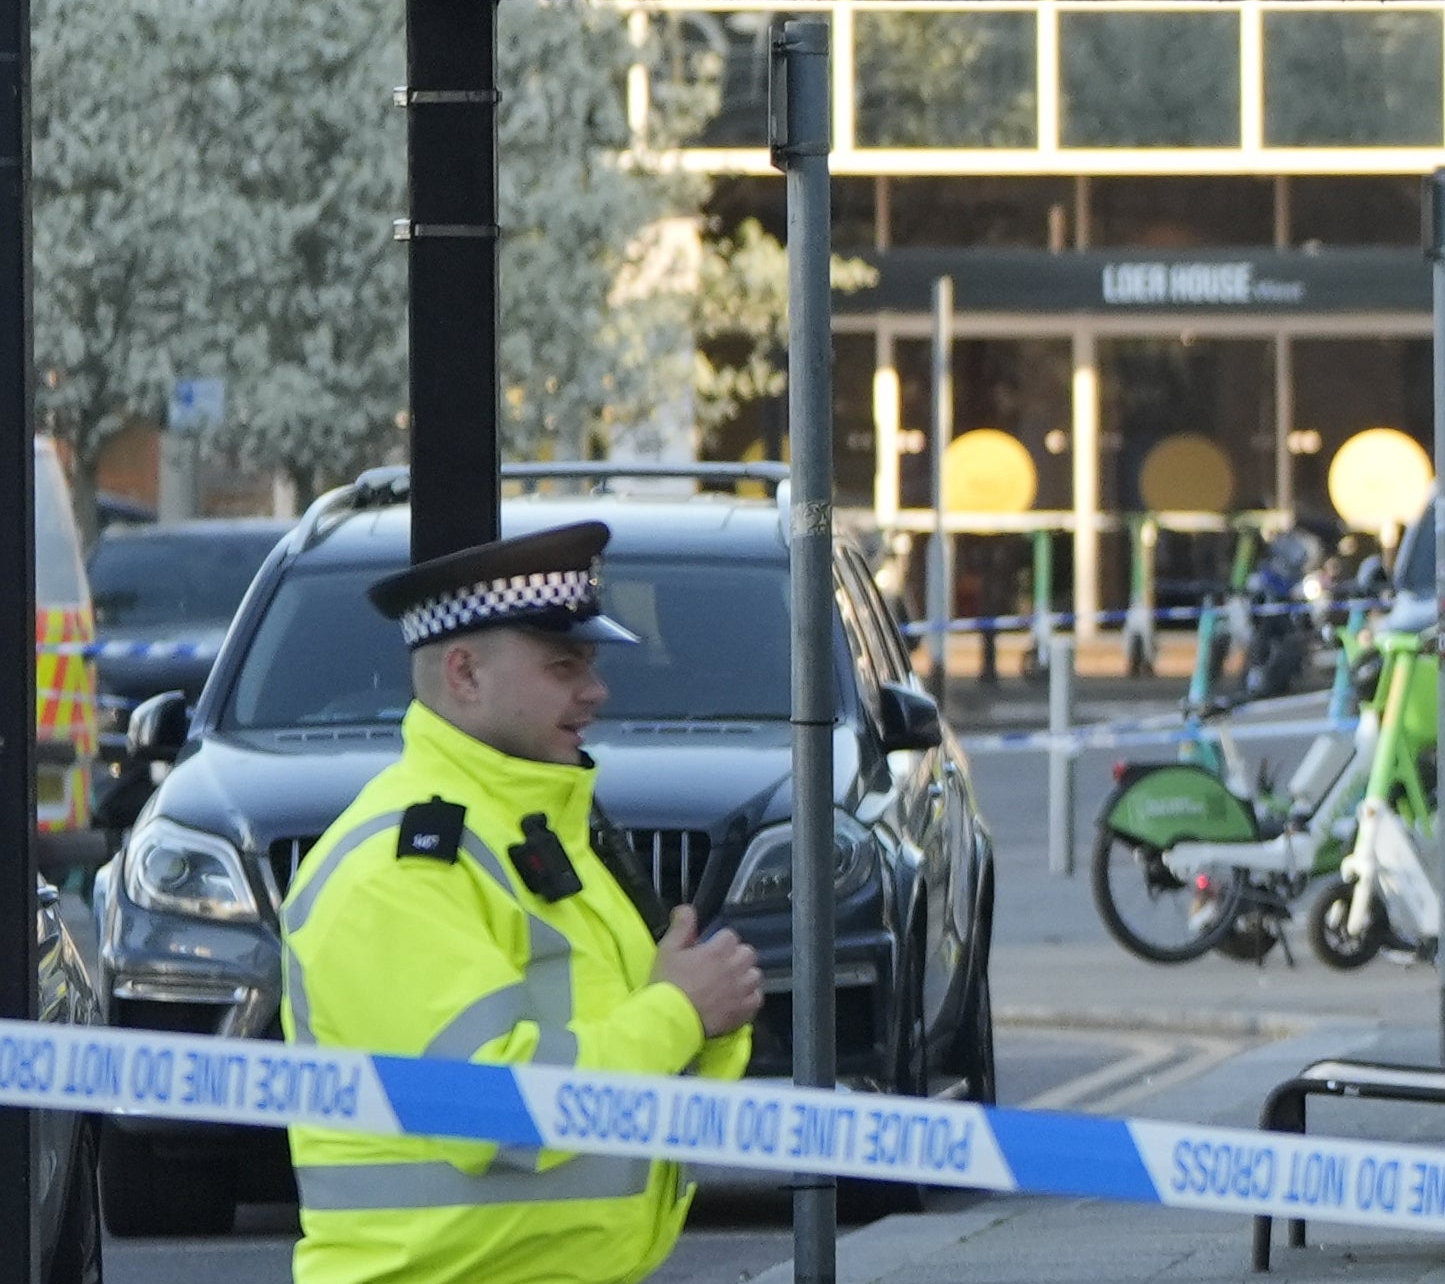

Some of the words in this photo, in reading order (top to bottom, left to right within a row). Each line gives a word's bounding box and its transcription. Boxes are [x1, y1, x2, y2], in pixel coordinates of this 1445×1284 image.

[0, 1035, 55, 1093] CRO
[62, 1040, 125, 1098] NOT
[130, 1045, 175, 1103] DO
[180, 1050, 250, 1108] LINE
[258, 1057, 363, 1116] POLICE
[554, 1081, 660, 1145] CROSS
[664, 1089, 731, 1149] NOT
[736, 1097, 781, 1156] DO
[789, 1102, 857, 1164] LINE
[865, 1108, 973, 1172] POLICE
[1170, 1138, 1275, 1201] CROSS
[1282, 1148, 1346, 1208] NOT
[1355, 1156, 1401, 1214] DO
